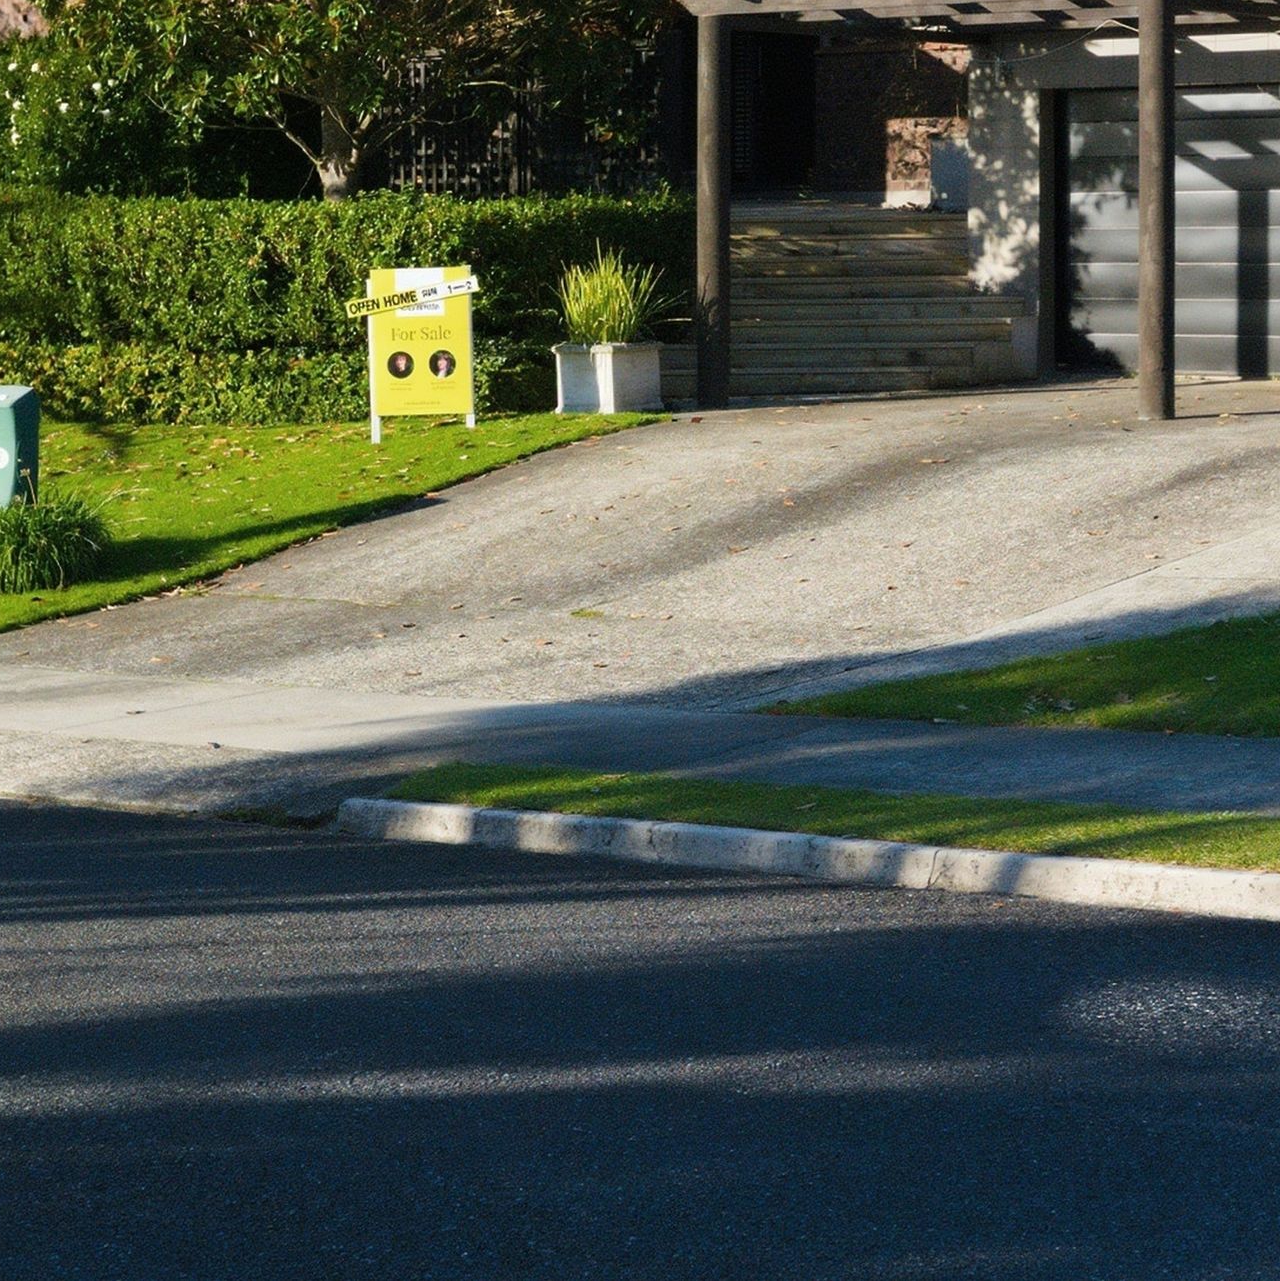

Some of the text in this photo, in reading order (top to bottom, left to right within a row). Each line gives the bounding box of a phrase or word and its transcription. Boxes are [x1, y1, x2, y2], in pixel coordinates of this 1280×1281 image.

[349, 298, 380, 315] OPEN
[383, 290, 418, 308] HOME
[391, 325, 452, 341] For Sale
